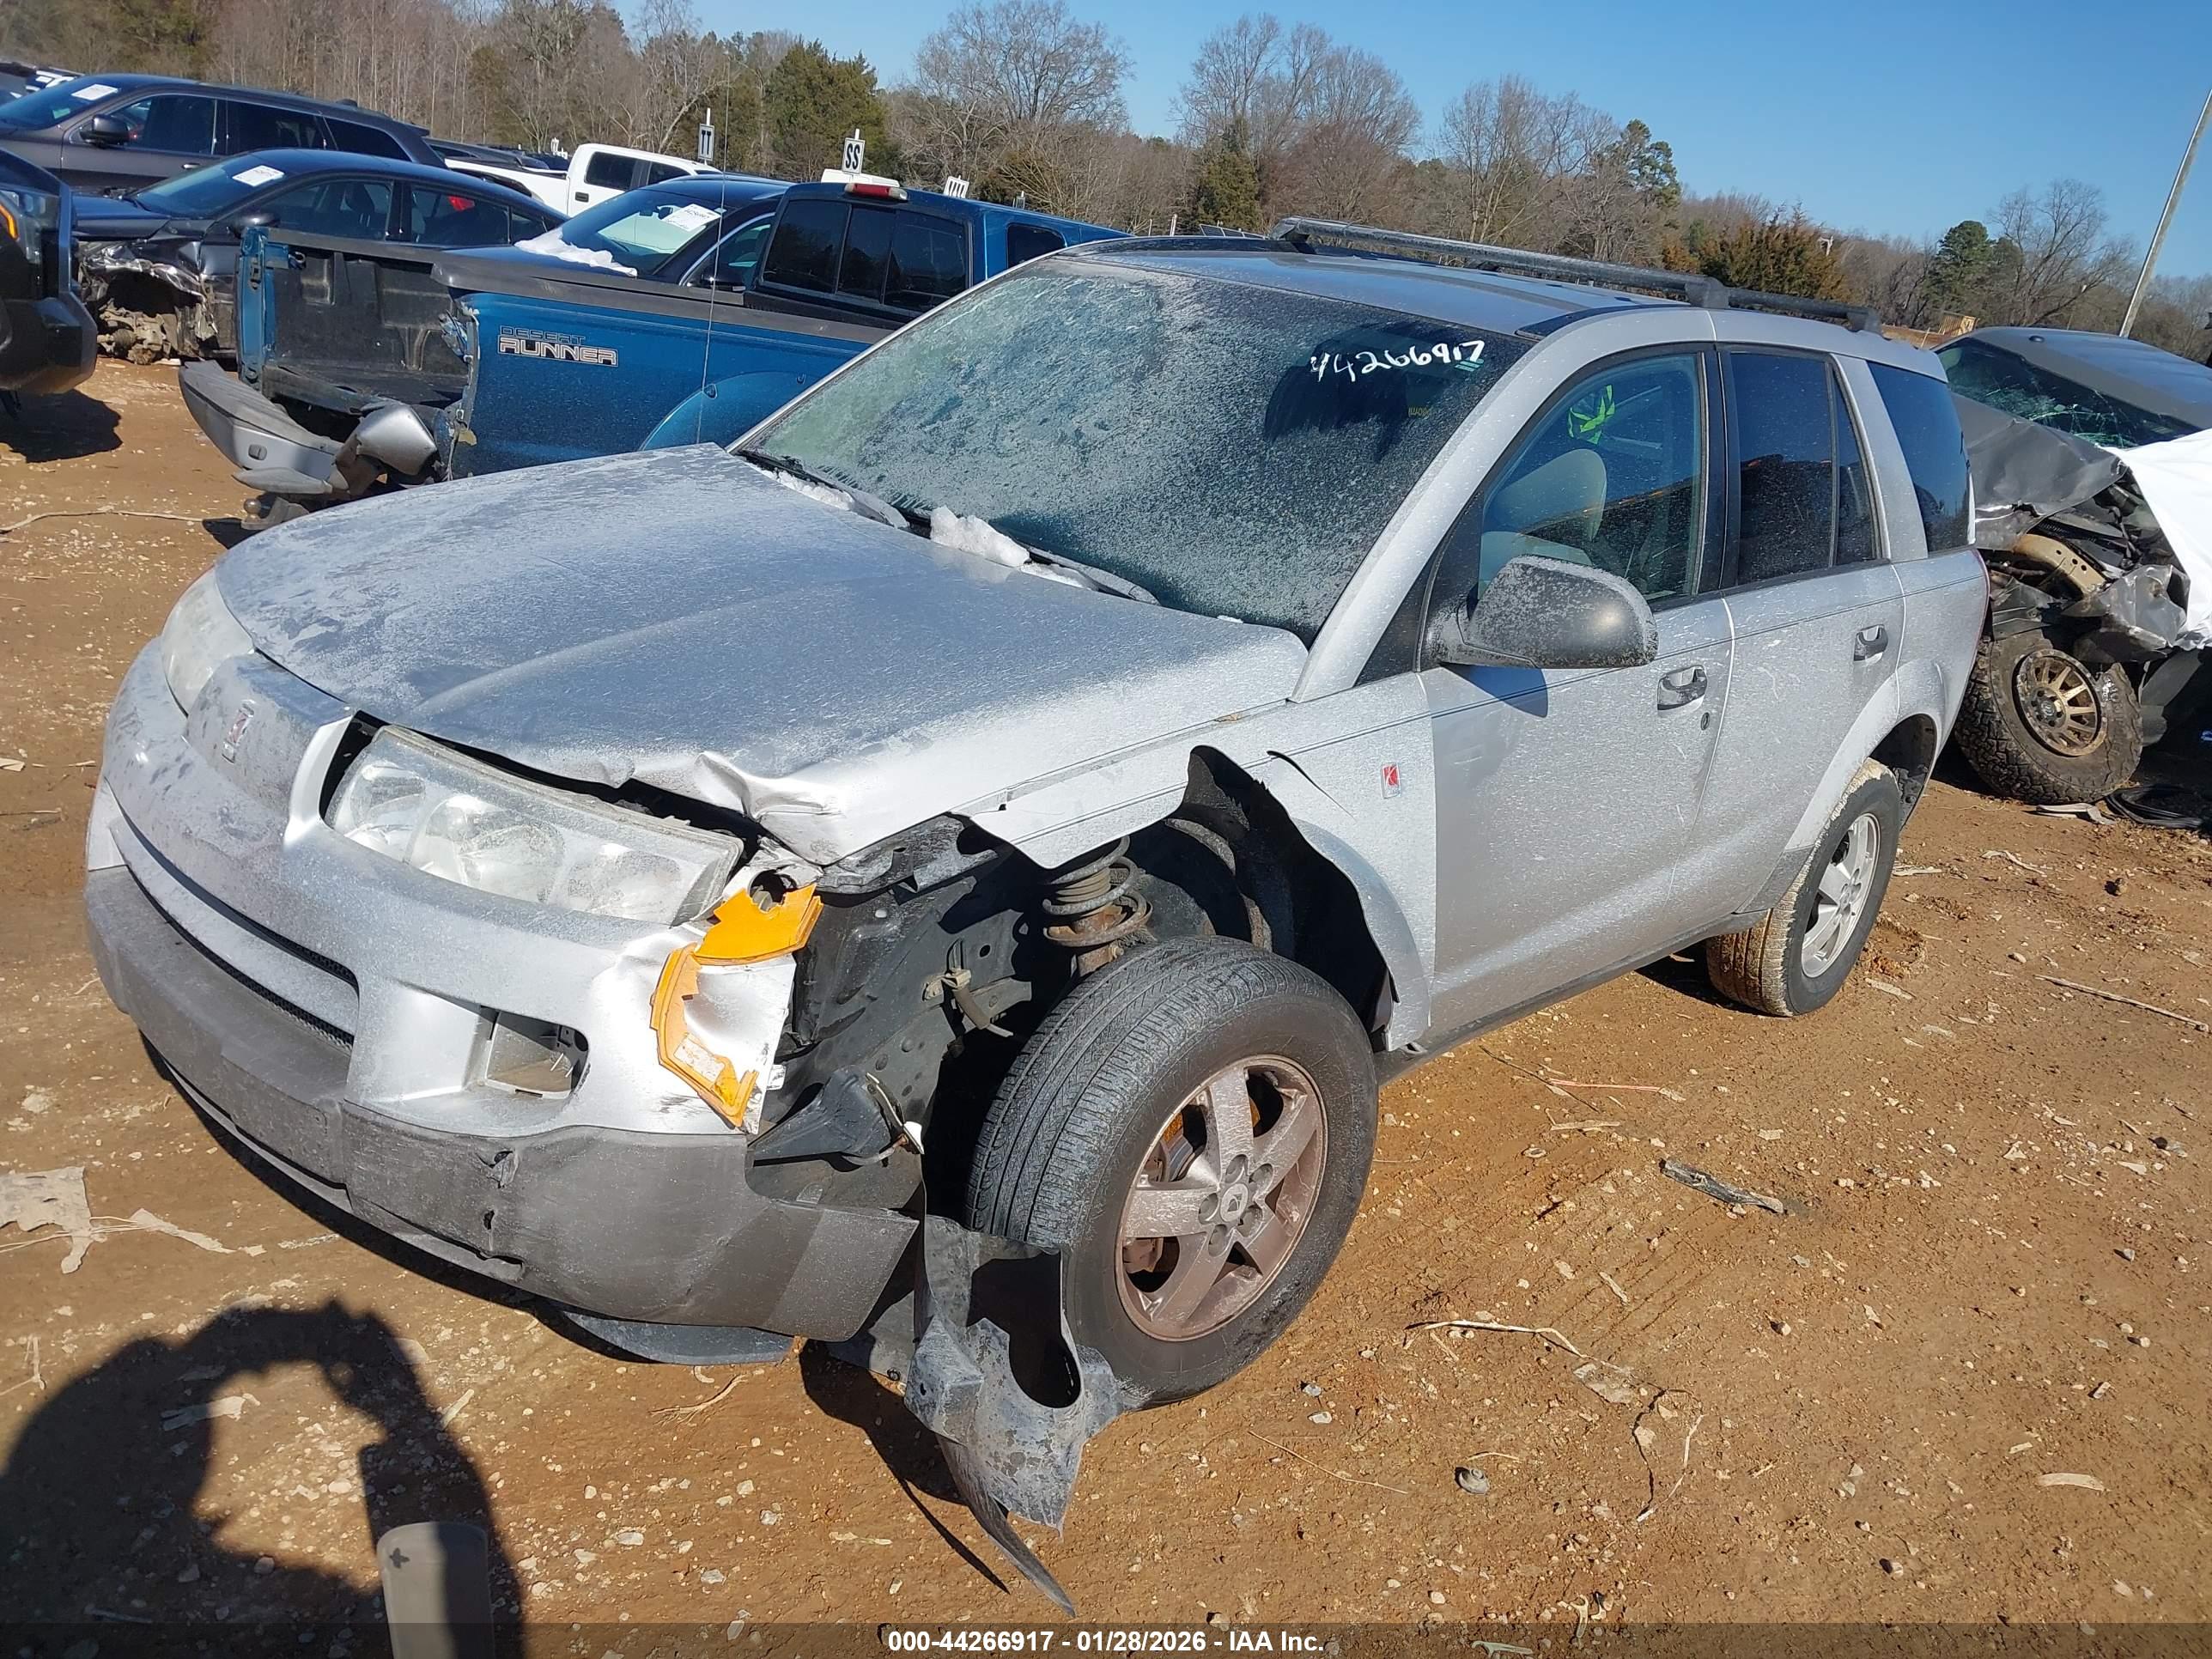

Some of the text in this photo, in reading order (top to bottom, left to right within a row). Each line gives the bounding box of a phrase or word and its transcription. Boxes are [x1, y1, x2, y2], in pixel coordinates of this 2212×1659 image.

[701, 130, 712, 155] TT
[845, 143, 860, 170] SS
[500, 325, 586, 345] DESERT
[499, 336, 617, 366] RUNNER
[1310, 339, 1486, 383] 44266917
